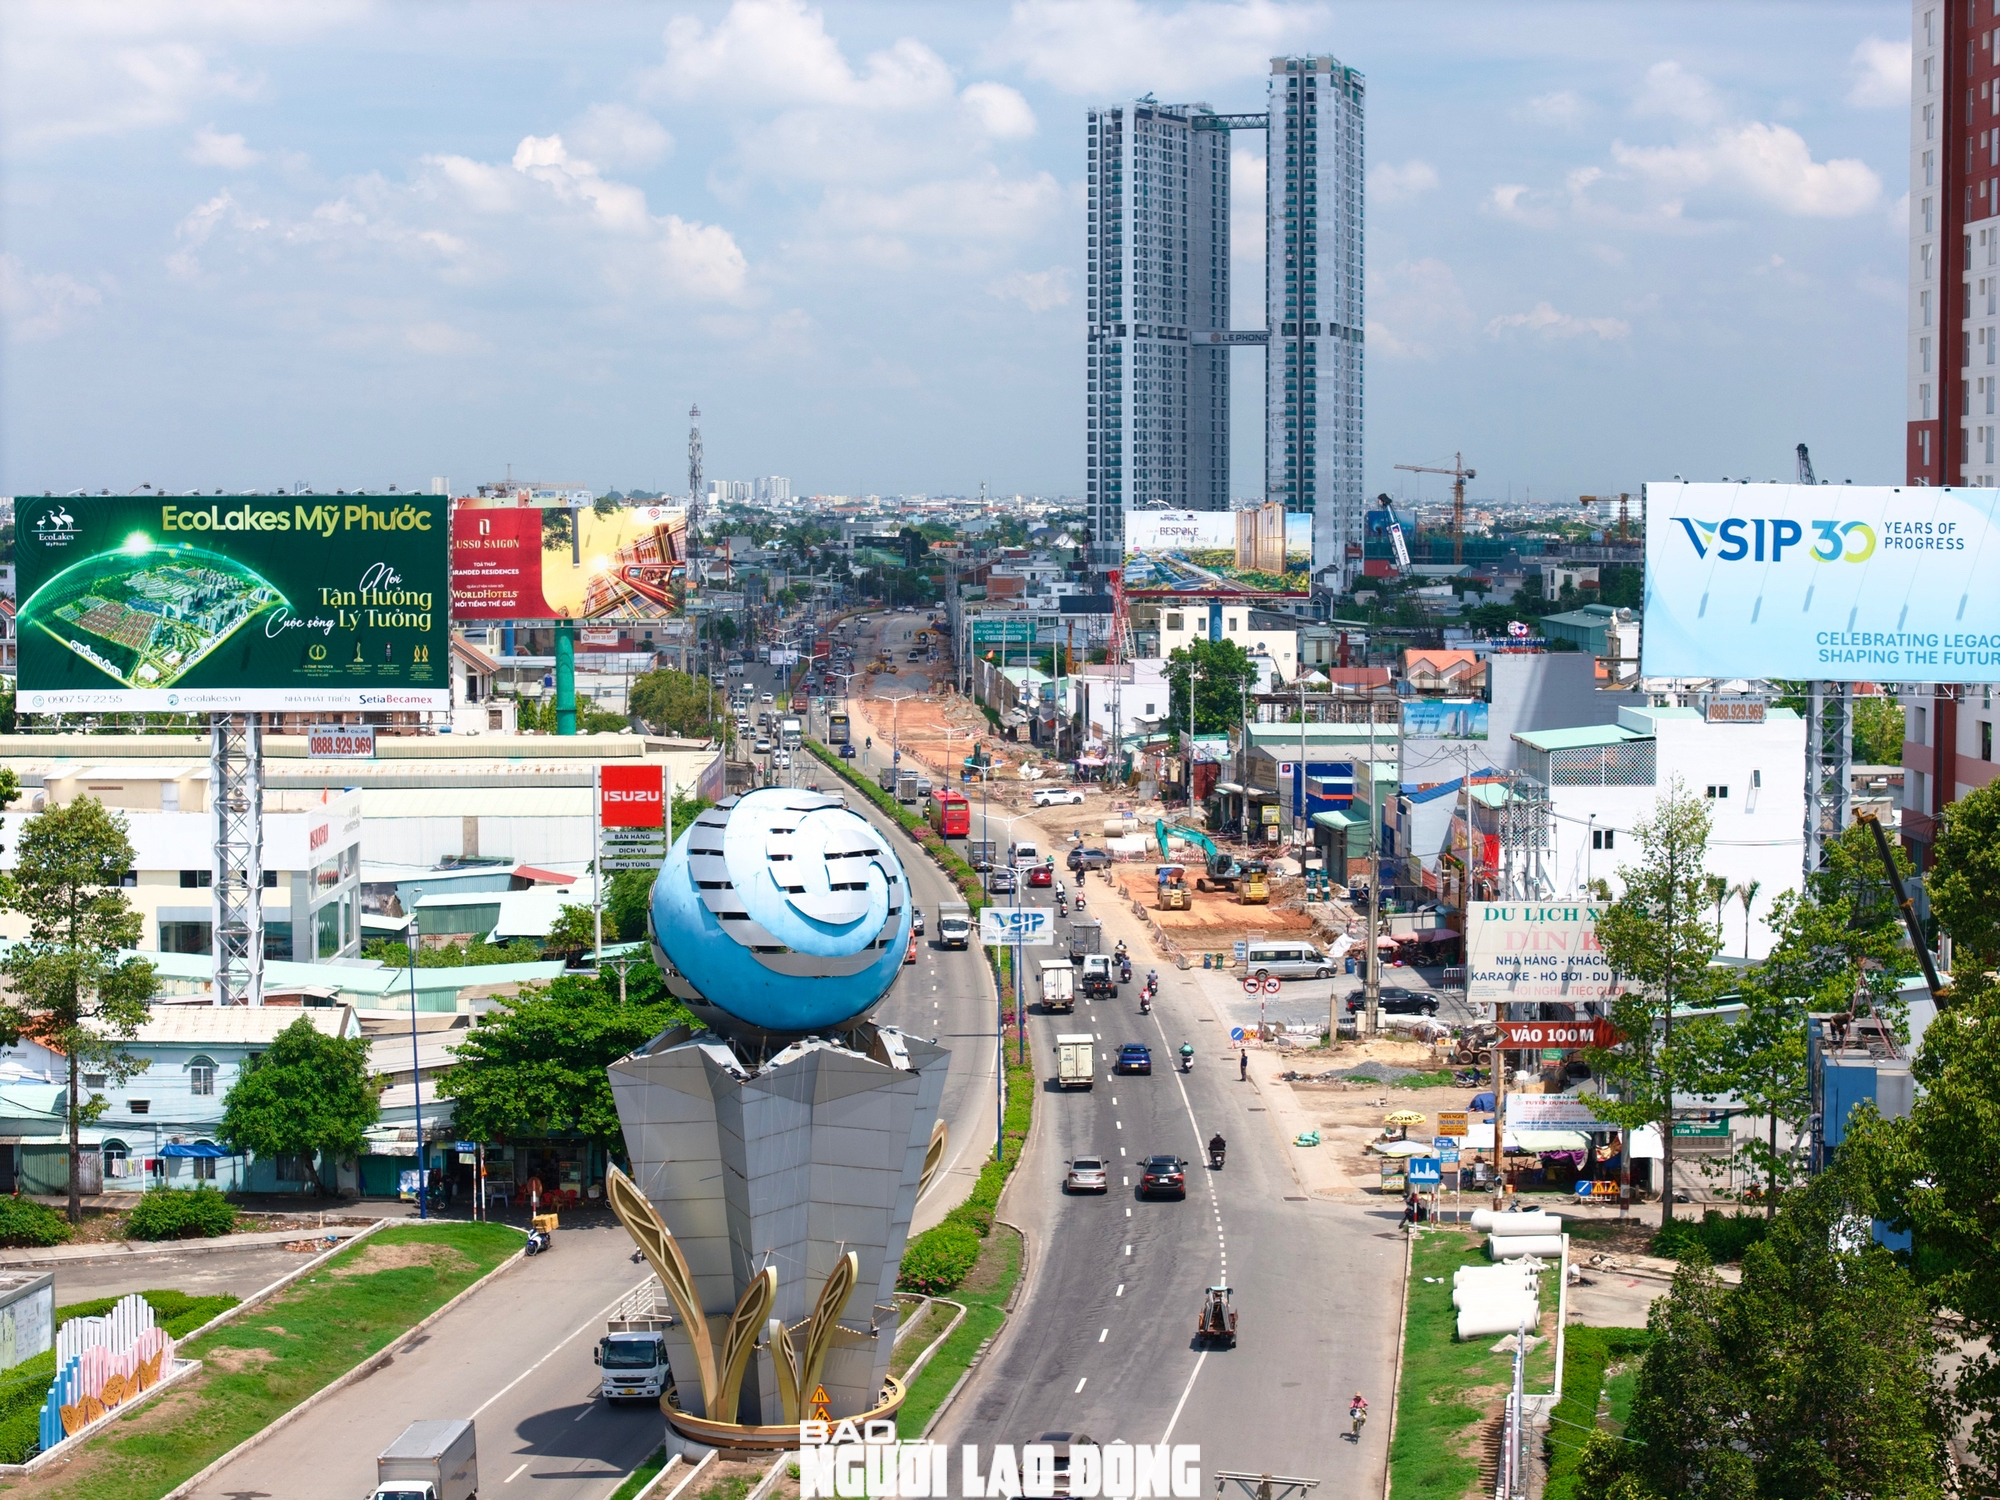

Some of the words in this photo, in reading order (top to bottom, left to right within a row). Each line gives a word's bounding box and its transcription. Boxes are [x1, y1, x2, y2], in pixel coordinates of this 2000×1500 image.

[1236, 334, 1269, 342] PHONG
[162, 505, 291, 531] EcoLakes
[295, 505, 340, 537] Mỹ
[345, 504, 432, 531] Phước
[1884, 522, 1934, 535] YEARS
[1938, 522, 1957, 534] OF
[39, 533, 74, 541] EcoLakes
[454, 539, 481, 549] USSO
[484, 539, 519, 549] SAIGON
[1670, 517, 1802, 562] VSIP
[1809, 520, 1876, 563] 30
[1884, 537, 1965, 550] PROGRESS
[318, 588, 356, 610] Tận
[362, 587, 432, 611] Hưởng
[265, 607, 304, 638] Cuộc
[339, 609, 362, 631] Lý
[365, 609, 432, 632] Tưởng
[1816, 631, 1939, 648] CELEBRATING
[1818, 649, 1900, 664] SHAPING
[1905, 650, 1938, 664] THE
[77, 695, 90, 704] 57
[93, 695, 107, 704] 22
[109, 695, 123, 703] 55
[184, 694, 241, 703] ecolakes.vn
[359, 694, 433, 704] SetiaBecamex
[1709, 704, 1764, 720] 0888.929.969
[311, 736, 372, 754] 0888.929.969
[604, 791, 660, 802] ISUZU
[989, 912, 1045, 931] VSIP
[1484, 907, 1517, 922] DU
[1524, 907, 1579, 925] LỊCH
[1504, 925, 1569, 951] DÌN
[1496, 953, 1521, 965] NHÀ
[1524, 953, 1557, 965] HÀNG
[1568, 953, 1608, 966] KHÁCH
[1471, 972, 1529, 981] KARAOKE
[1540, 969, 1558, 981] HỒ
[1593, 972, 1609, 981] DU
[1570, 985, 1597, 997] TIỆC
[1511, 1025, 1542, 1042] VÀO
